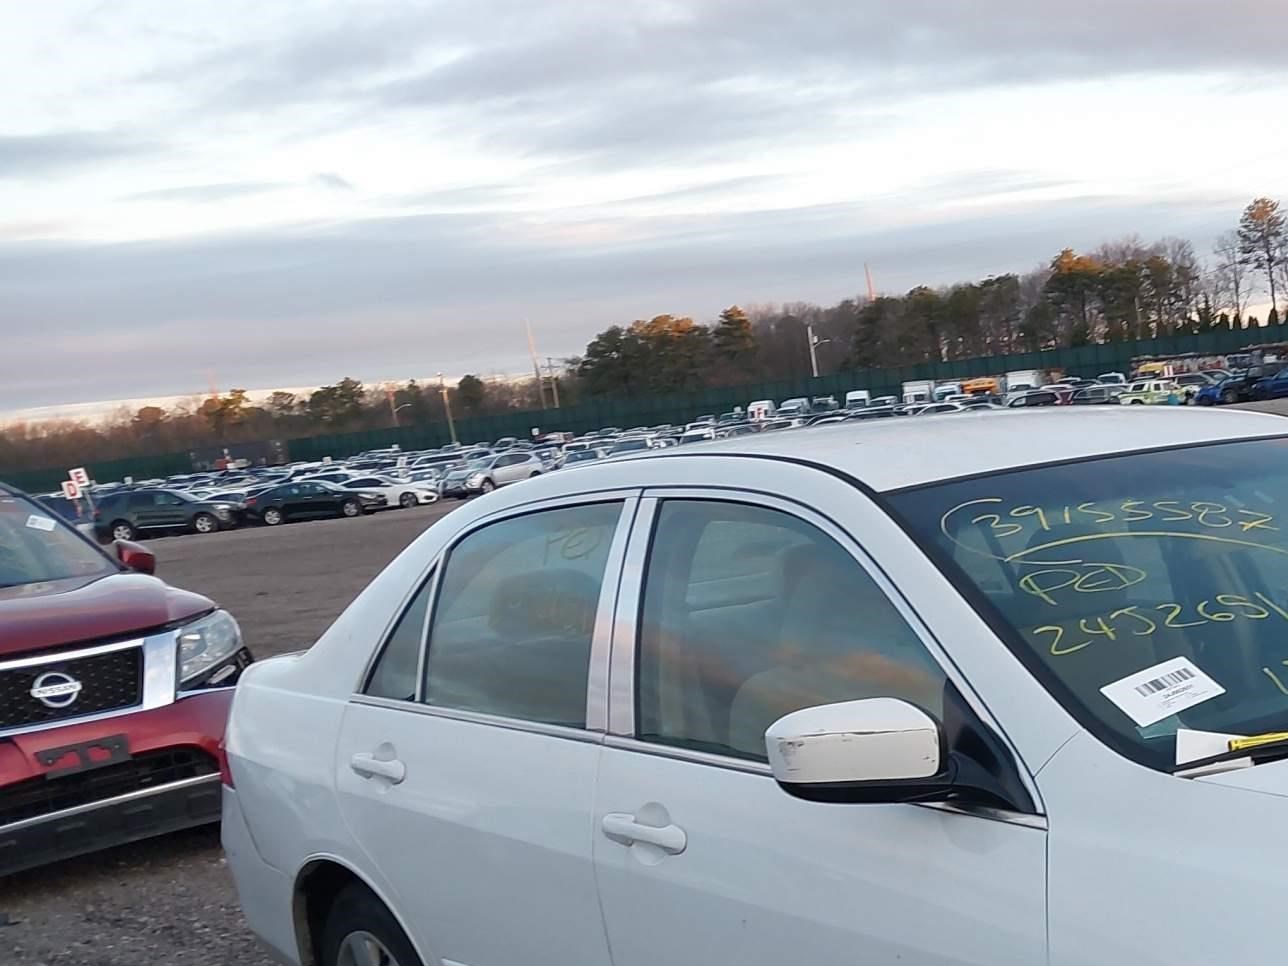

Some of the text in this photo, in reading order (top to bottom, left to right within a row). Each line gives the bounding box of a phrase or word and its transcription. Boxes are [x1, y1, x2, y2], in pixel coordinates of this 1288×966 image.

[73, 471, 86, 485] E
[66, 482, 77, 497] D
[971, 499, 1280, 538] 39155587
